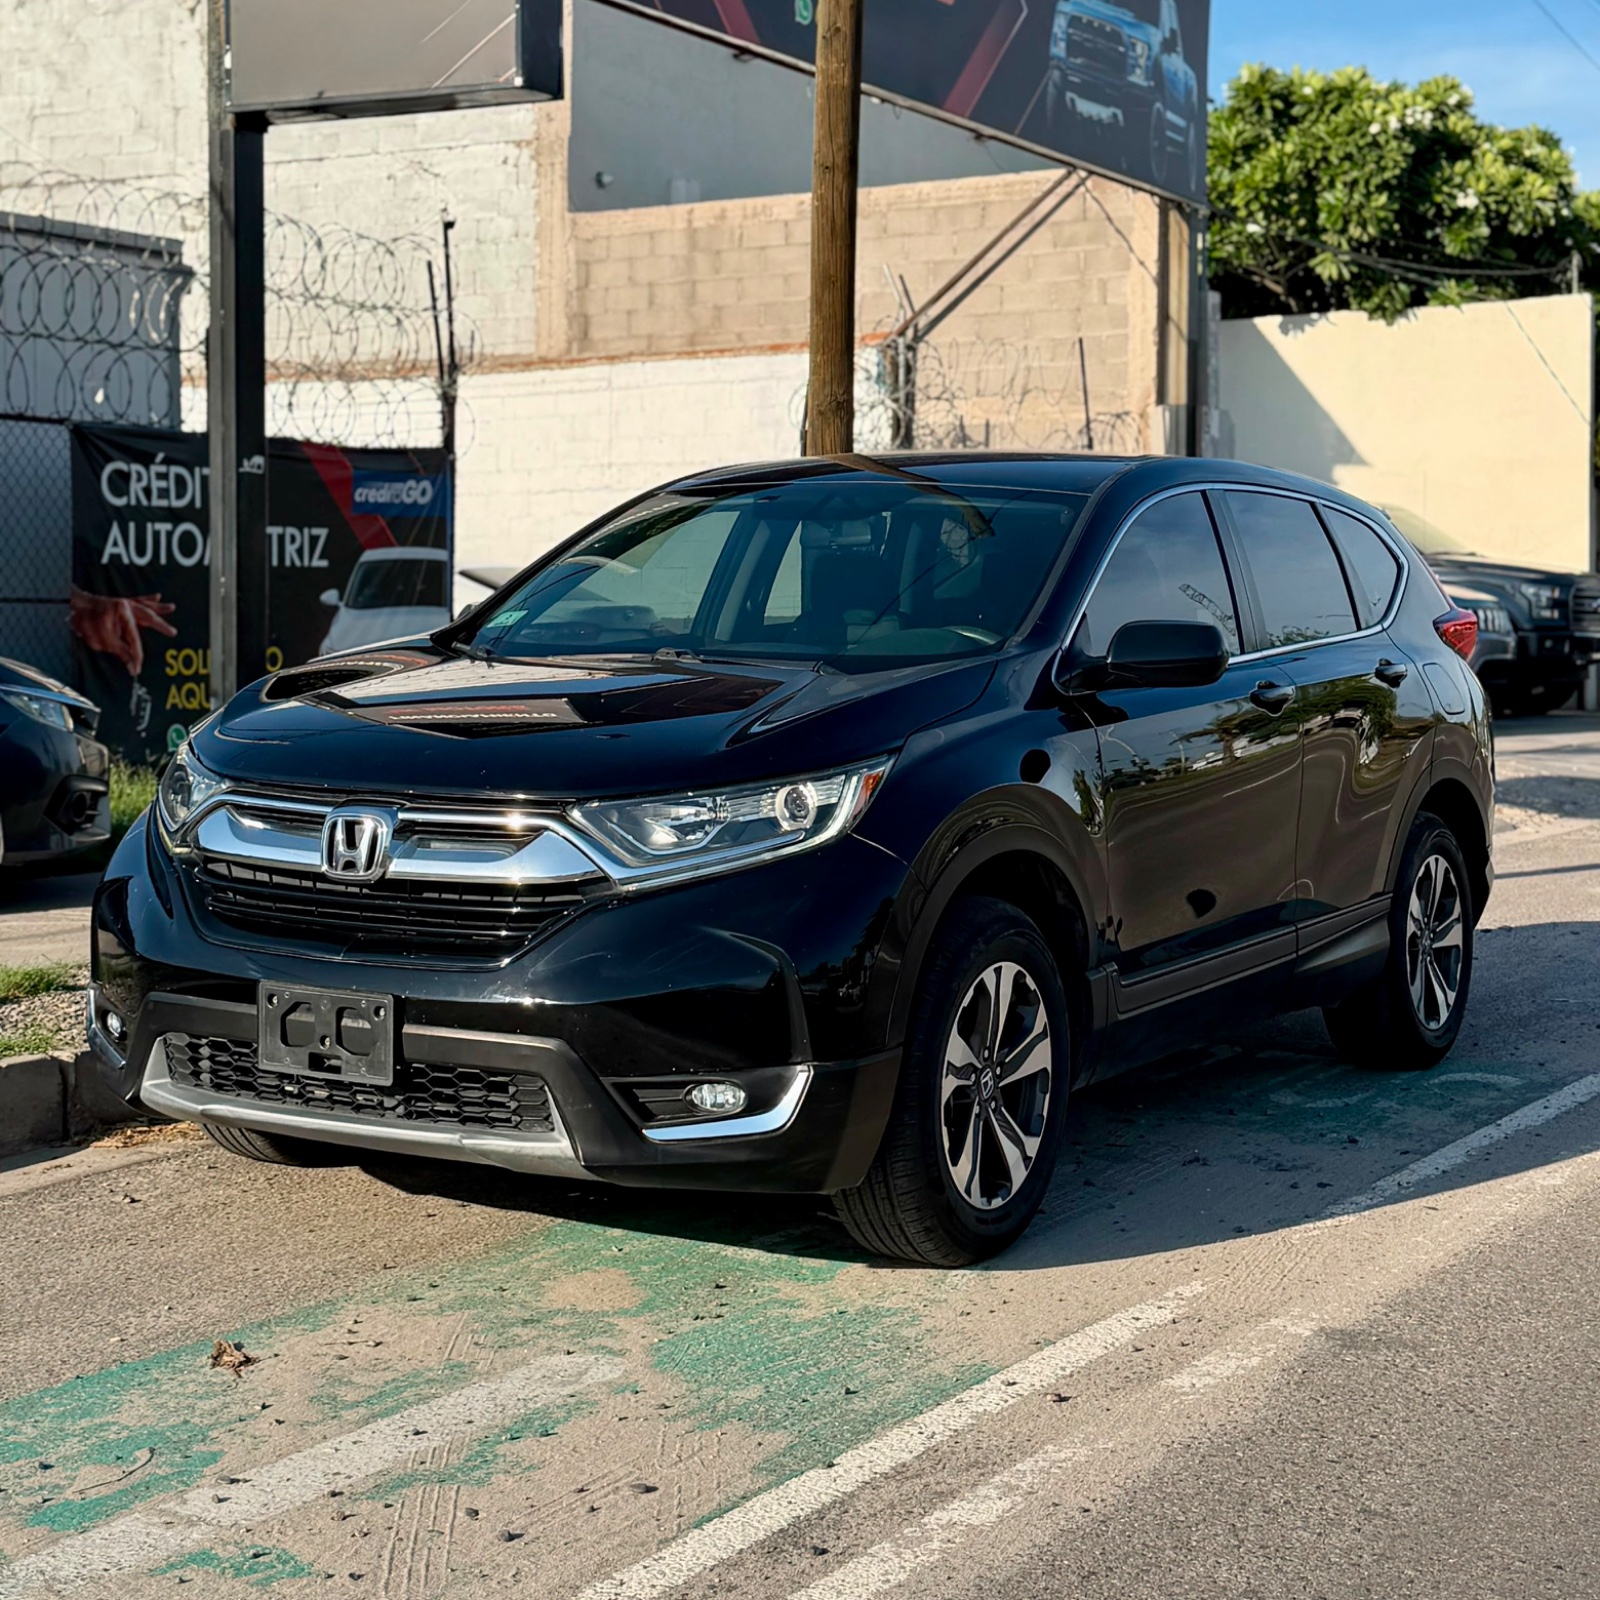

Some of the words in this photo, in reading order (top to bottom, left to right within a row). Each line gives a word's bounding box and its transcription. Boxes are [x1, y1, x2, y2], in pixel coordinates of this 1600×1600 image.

[100, 452, 211, 509] CRÉDI
[100, 520, 329, 568] AUTOTRIZ
[165, 682, 212, 710] AQU
